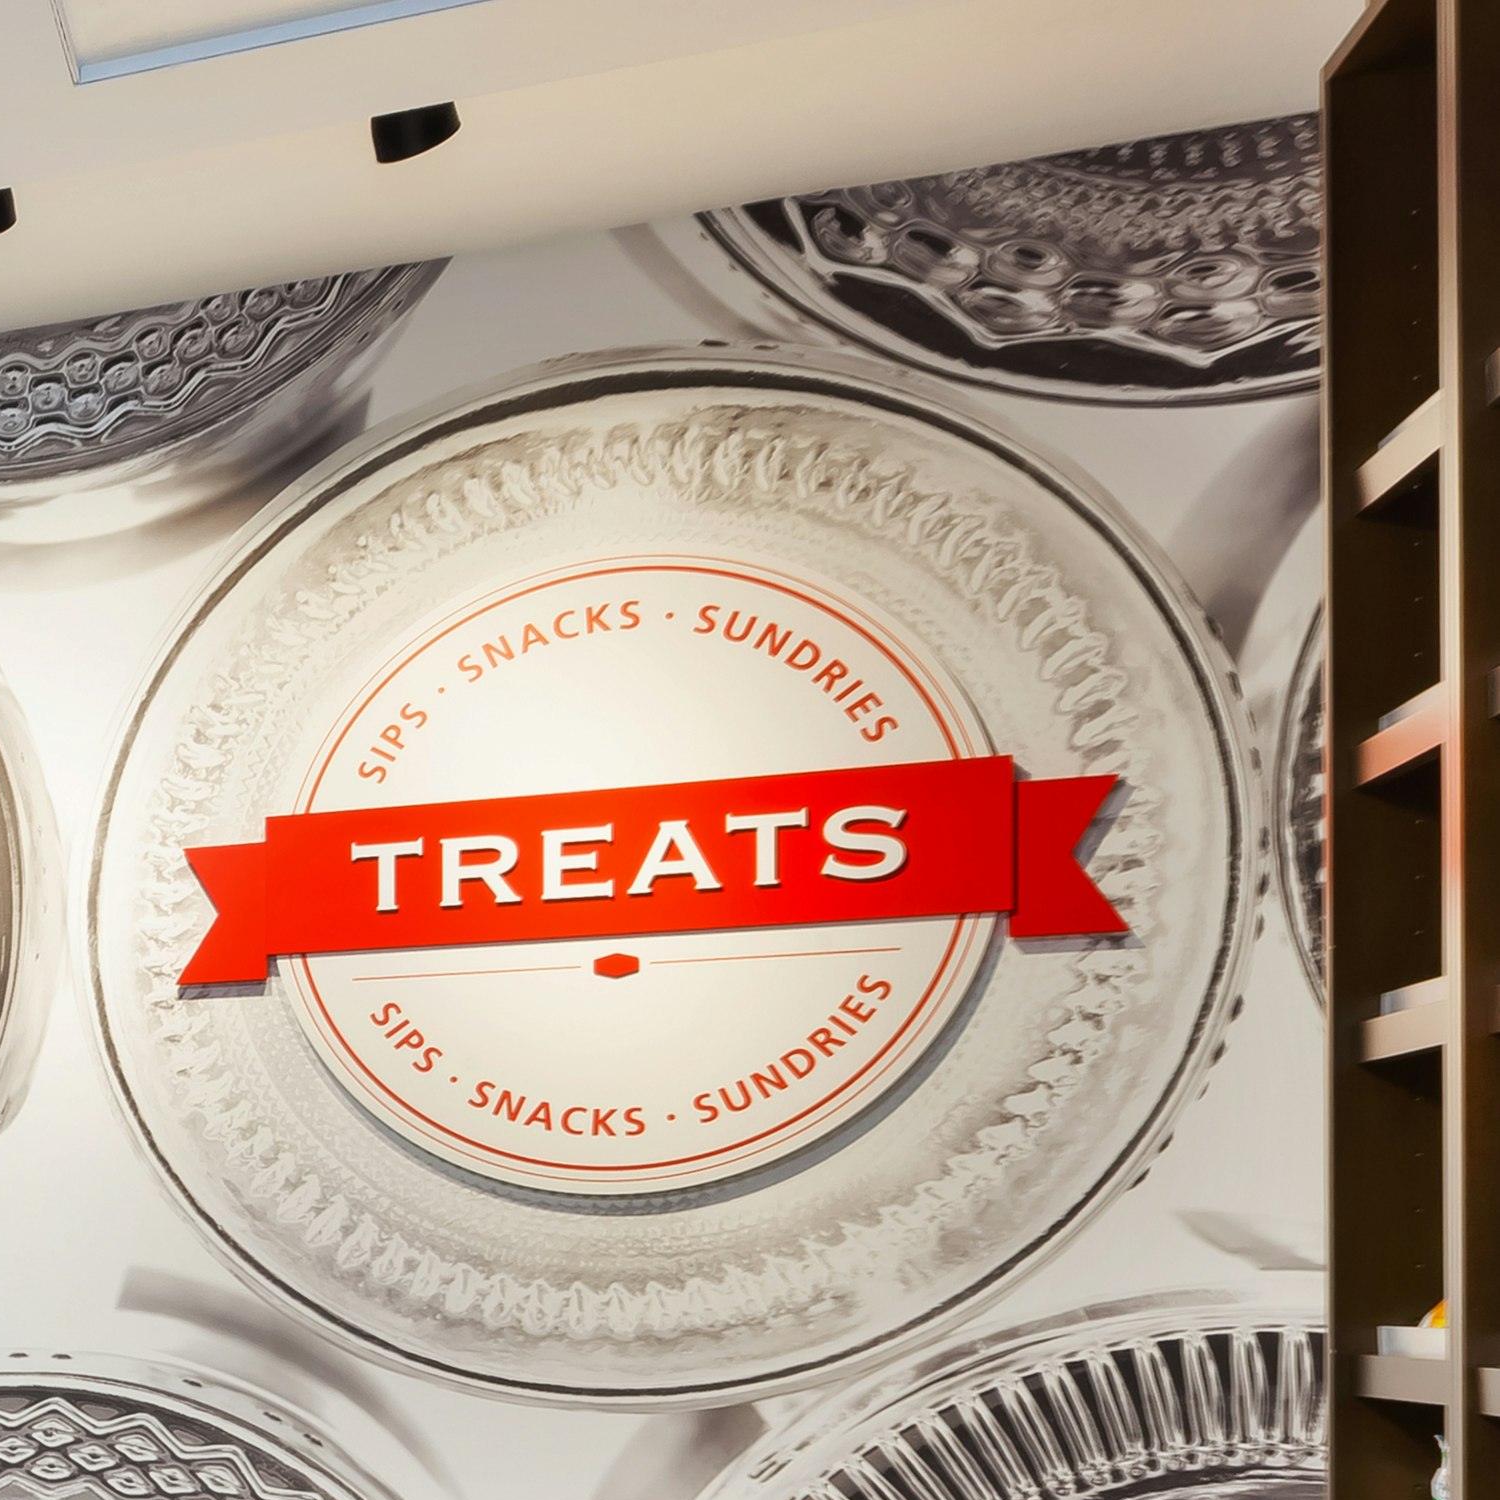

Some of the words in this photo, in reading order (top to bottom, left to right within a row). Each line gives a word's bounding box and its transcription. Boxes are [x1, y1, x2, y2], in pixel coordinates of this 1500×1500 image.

[358, 702, 429, 784] SIPS
[457, 600, 643, 683] SNACKS
[693, 604, 899, 745] SUNDRIES
[351, 806, 909, 913] TREATS
[371, 1002, 444, 1076] SIPS
[468, 1080, 647, 1138] SNACKS
[693, 973, 892, 1126] SUNDRIES
